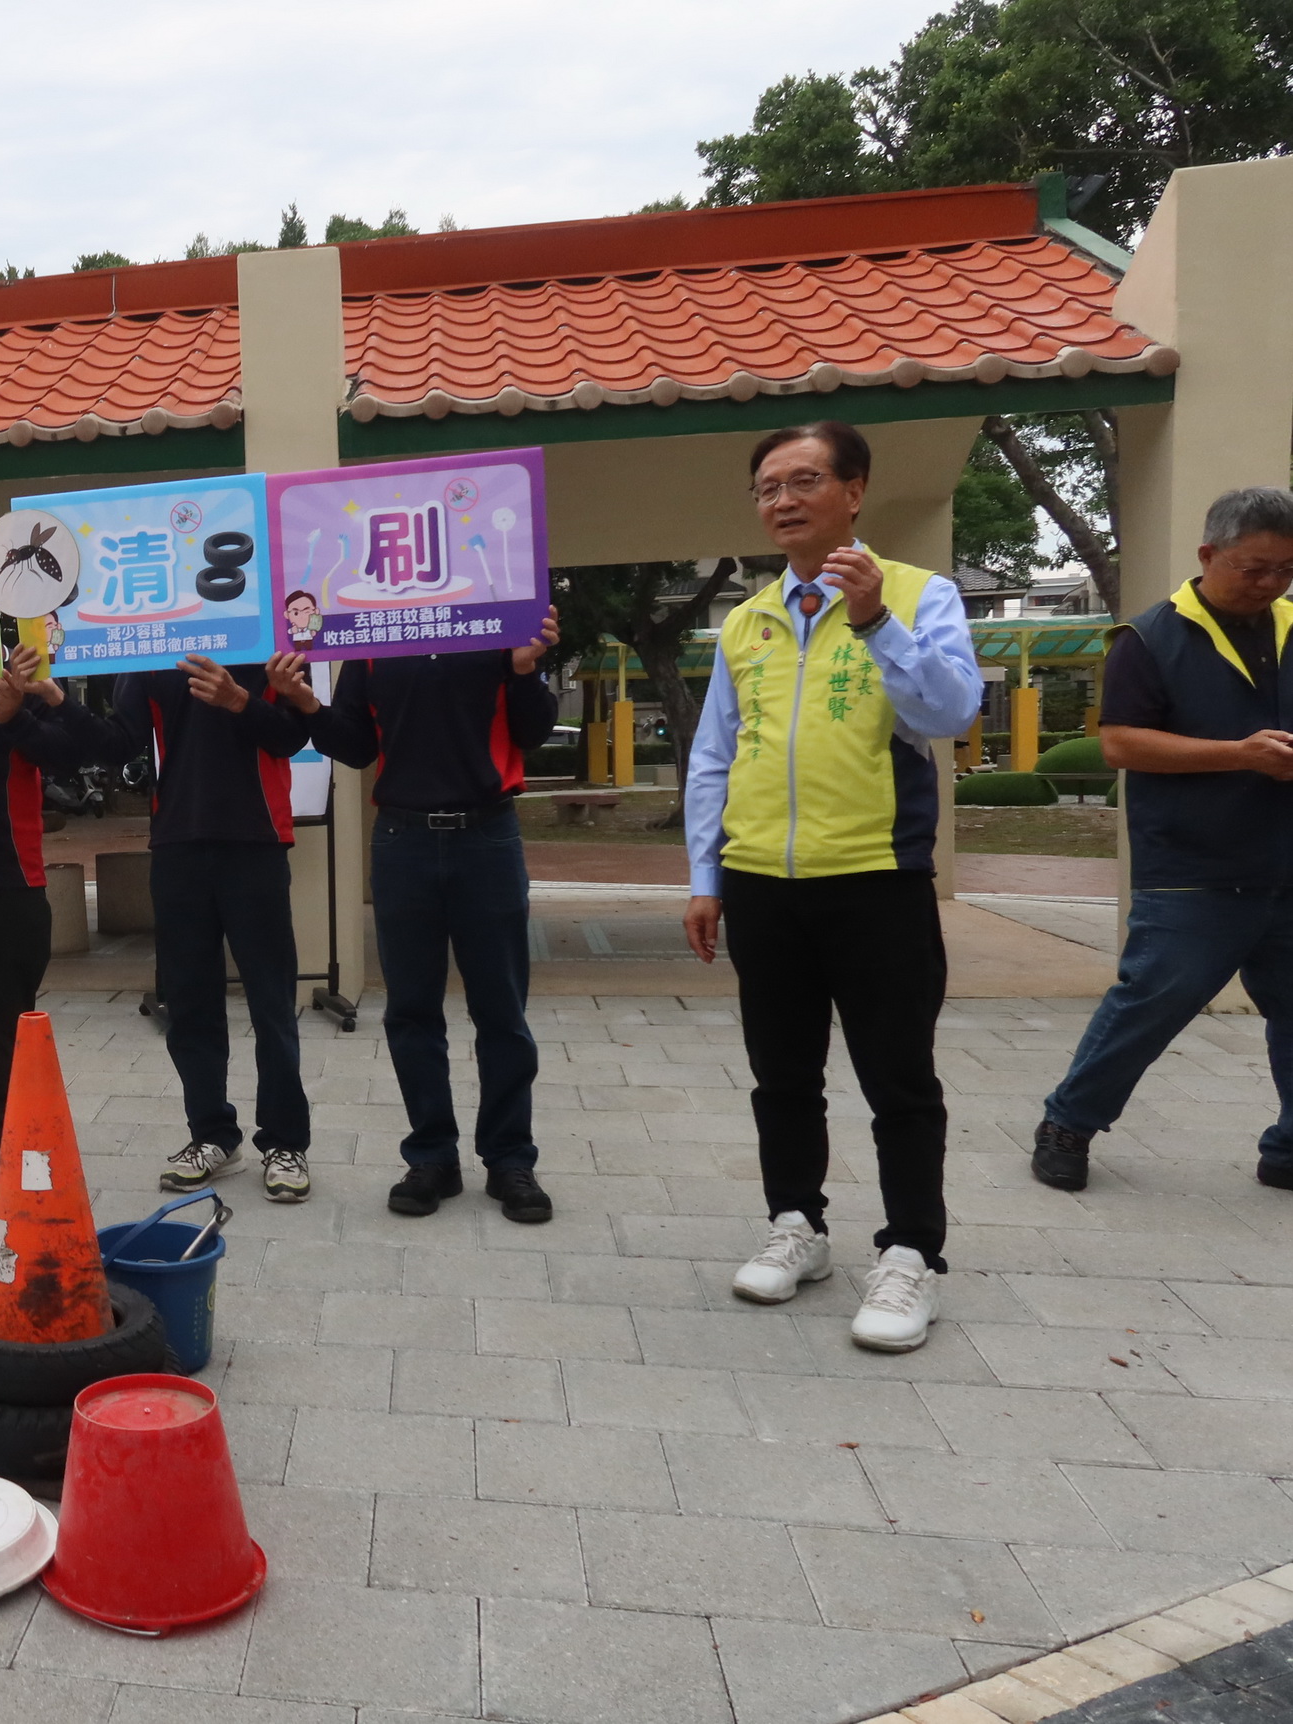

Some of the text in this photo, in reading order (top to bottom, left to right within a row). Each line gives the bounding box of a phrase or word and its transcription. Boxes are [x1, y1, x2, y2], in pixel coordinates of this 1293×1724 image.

[100, 529, 174, 609] 清
[364, 504, 445, 590] 刷
[323, 618, 503, 646] 收拾或倒置勿再積水養蚊
[354, 606, 463, 628] 去除斑蚊蟲卵、
[64, 634, 228, 661] 留下的器具應都徹底清潔
[828, 643, 856, 722] 林世賢
